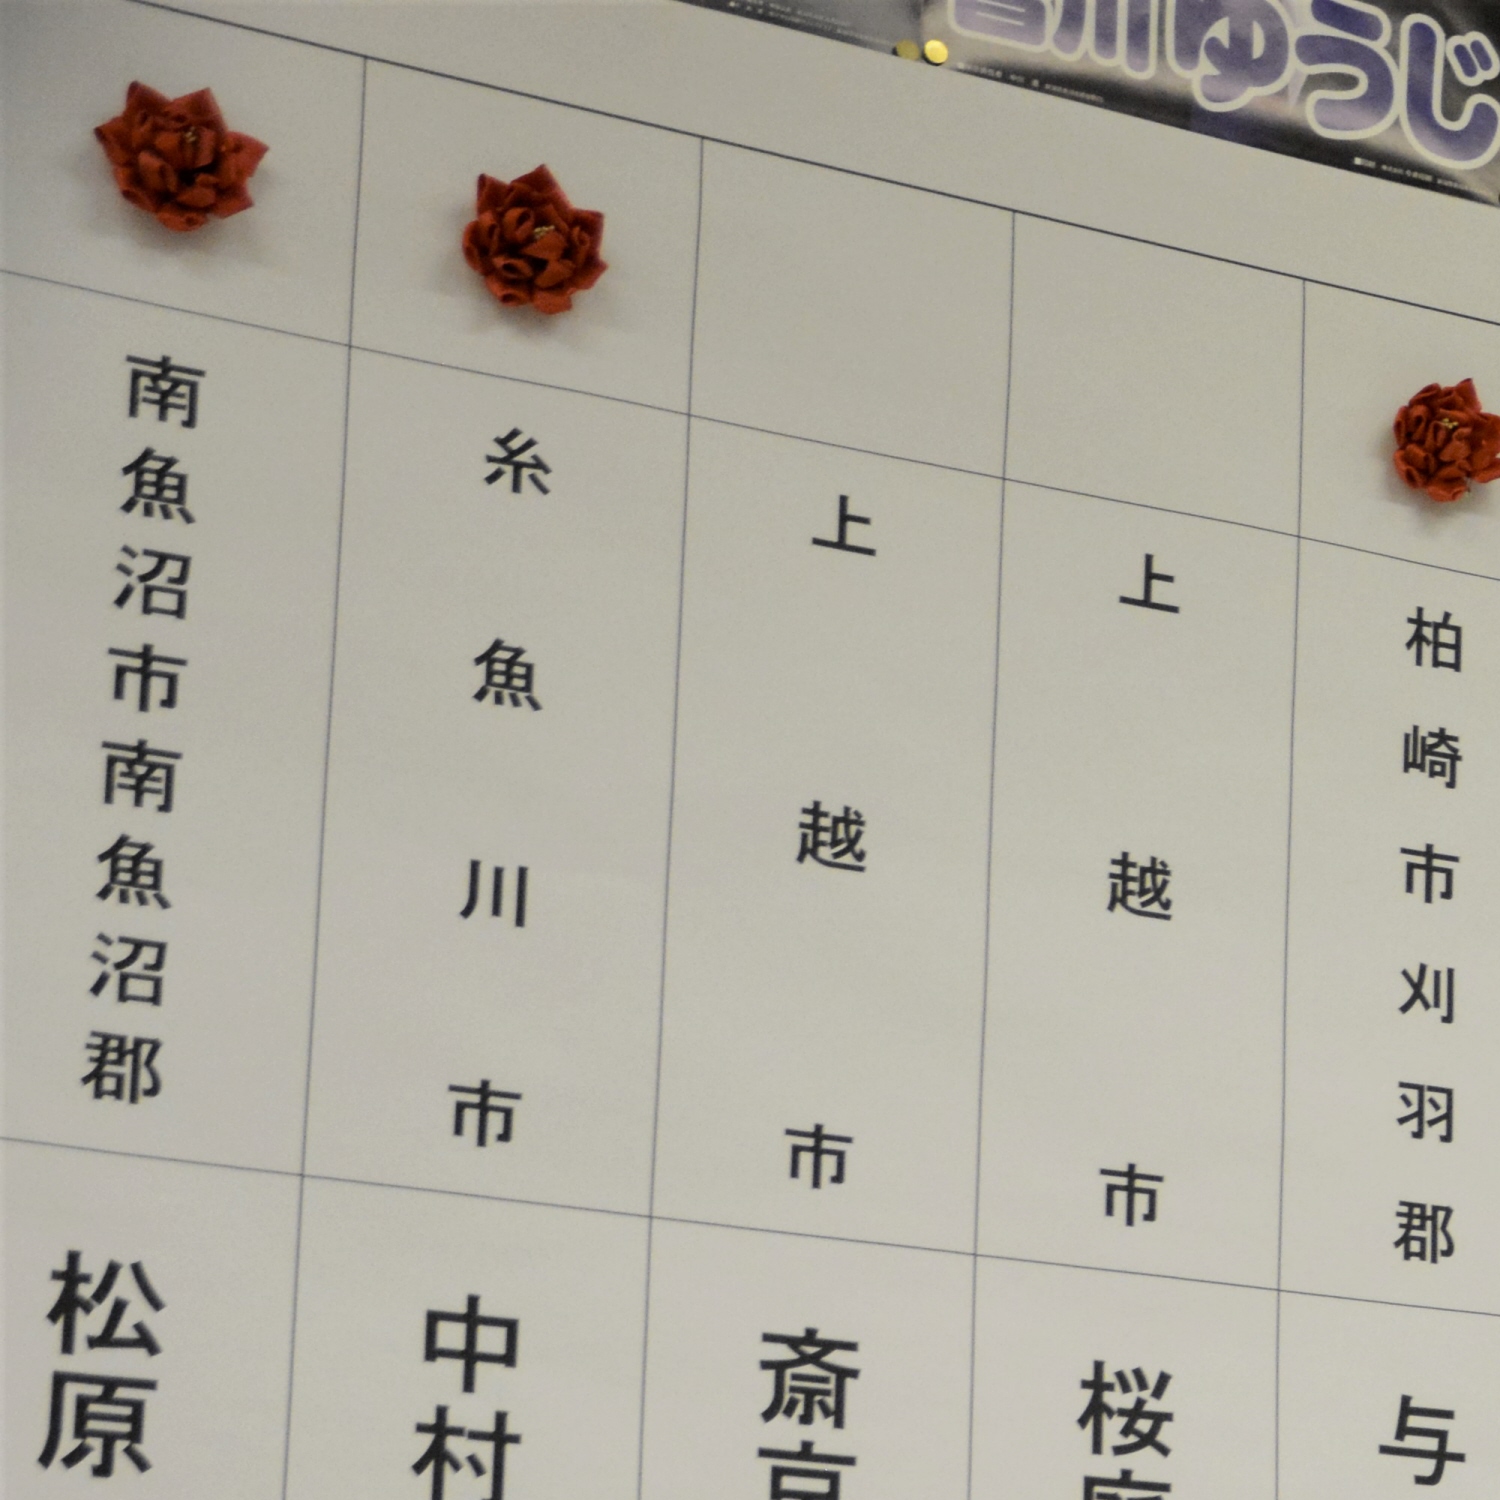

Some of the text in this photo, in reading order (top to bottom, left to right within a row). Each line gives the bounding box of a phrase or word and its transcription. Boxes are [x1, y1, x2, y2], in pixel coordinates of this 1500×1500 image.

[81, 355, 205, 1104] 南魚沼市南魚沼郡
[449, 428, 551, 1147] 糸魚川市
[785, 495, 876, 1188] 上越市
[1100, 554, 1179, 1226] 上越市
[1394, 607, 1462, 1264] 柏崎市刈羽郡
[38, 1250, 164, 1478] 松原
